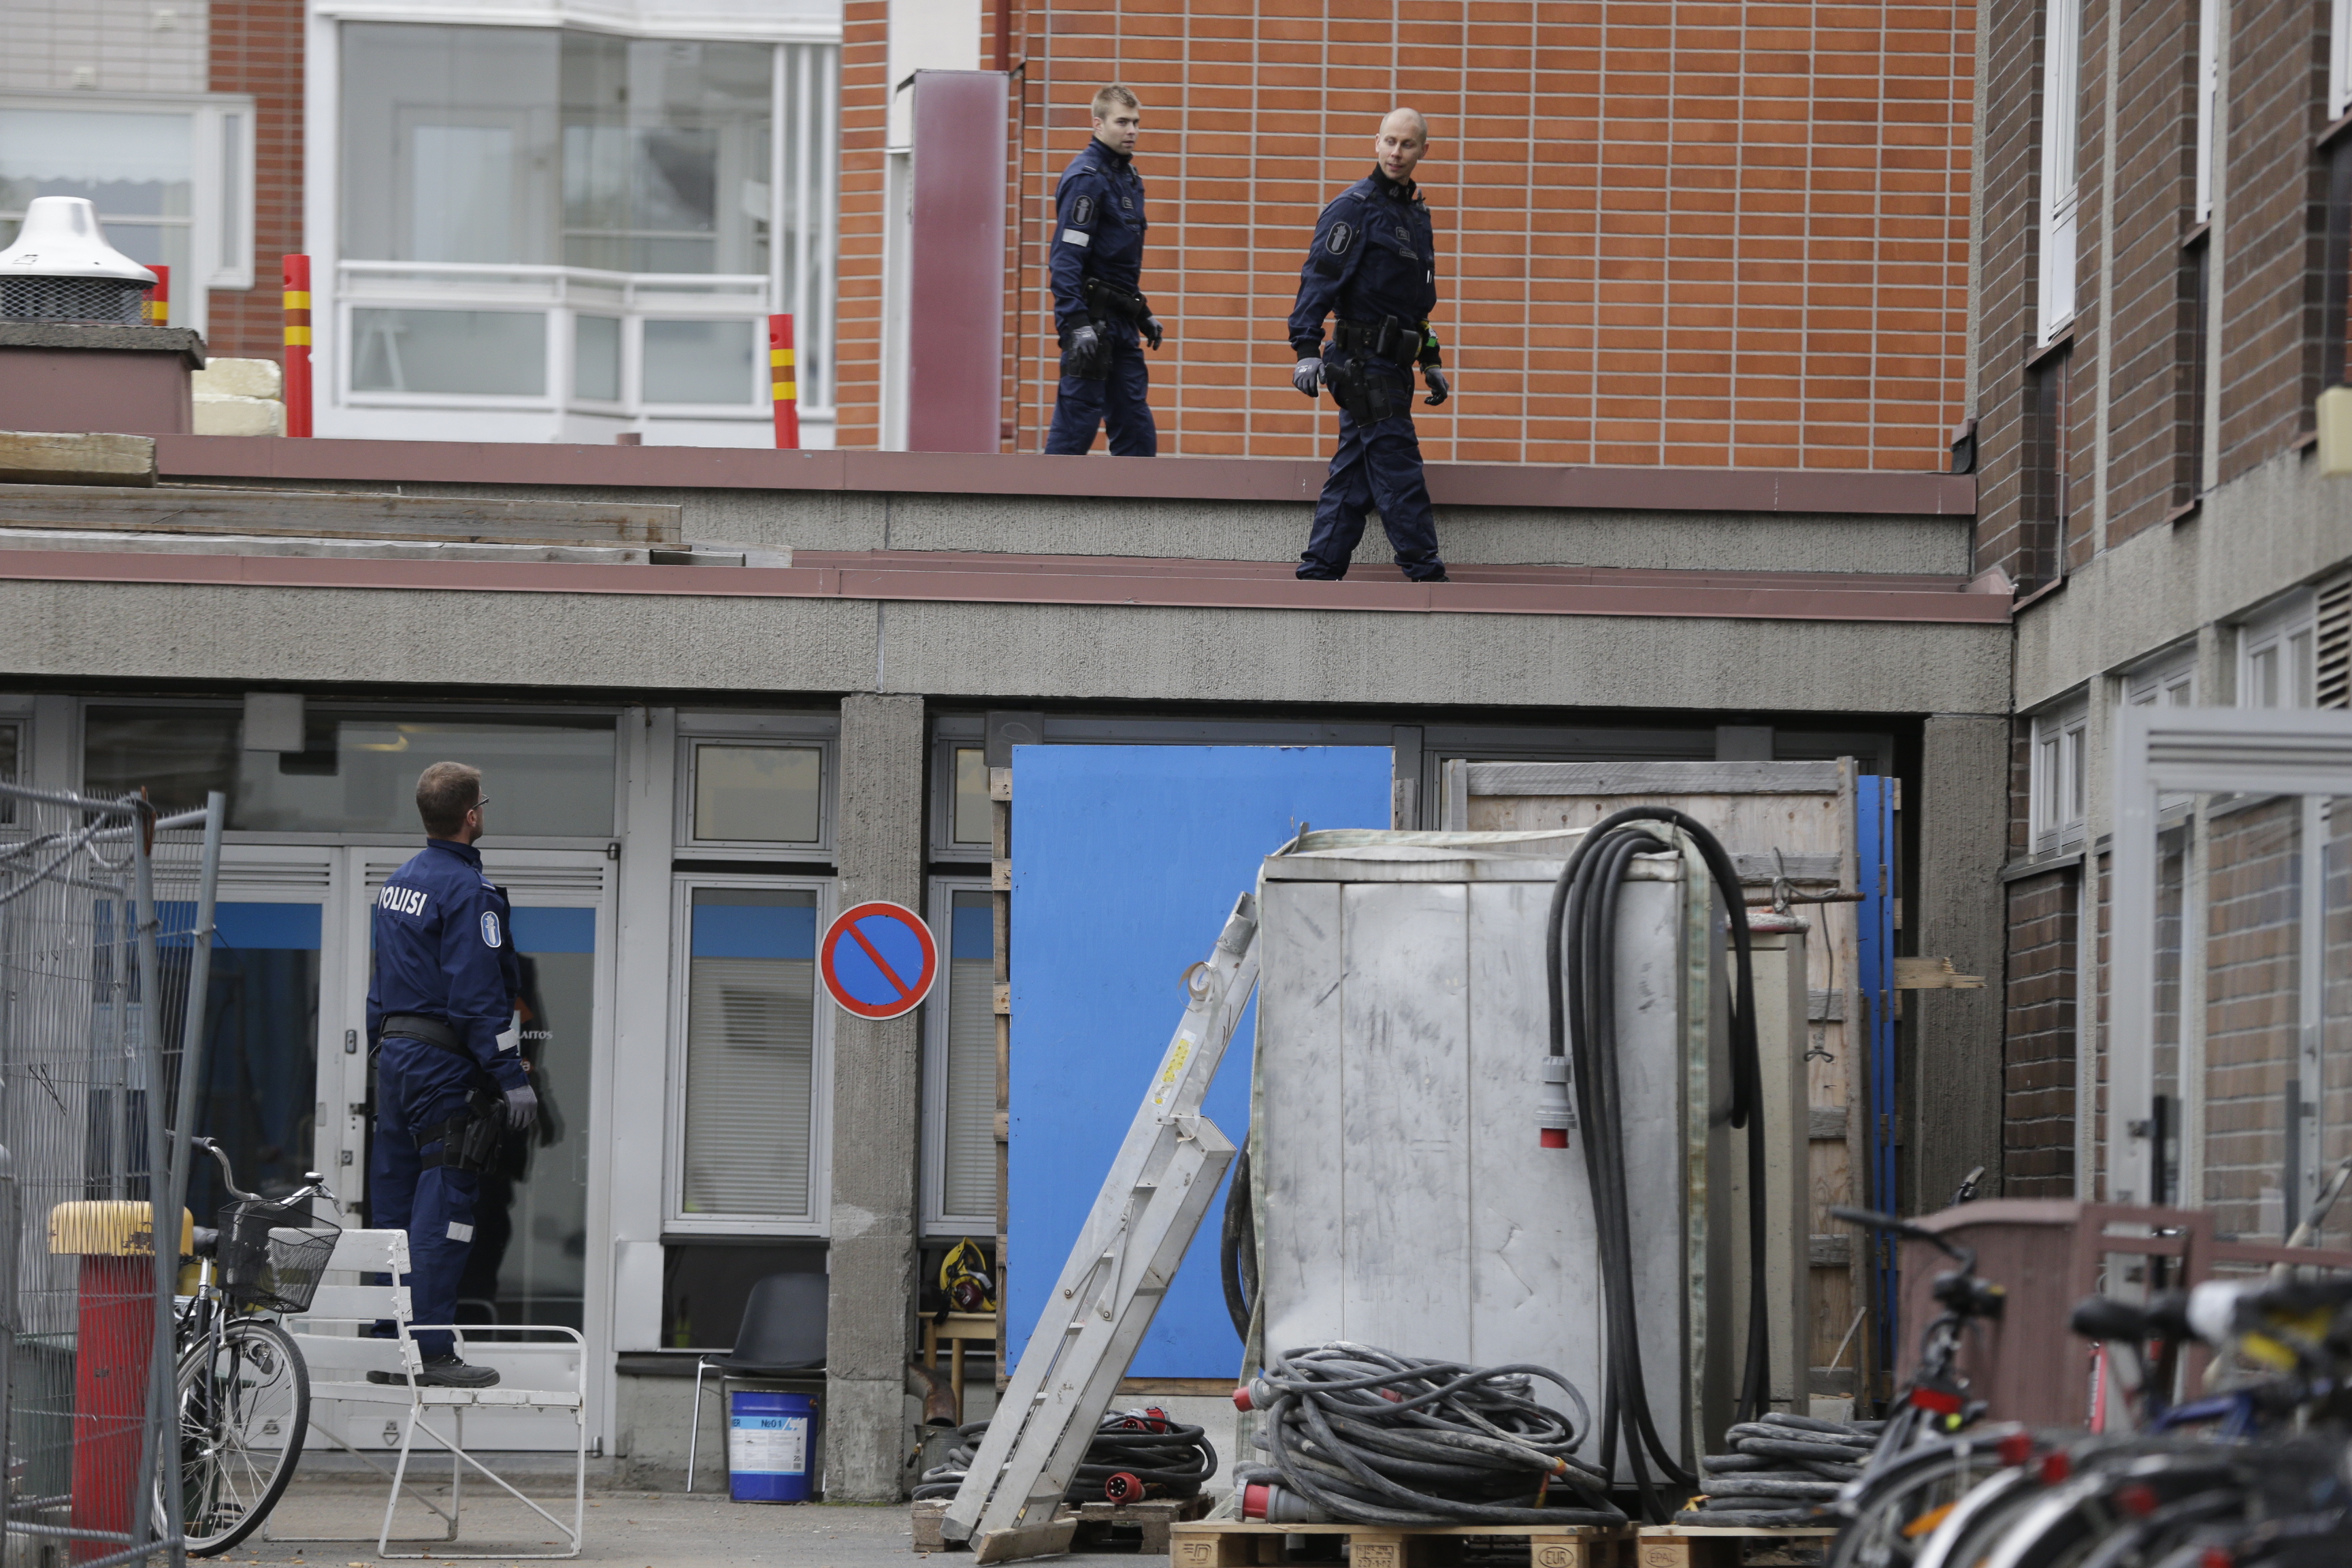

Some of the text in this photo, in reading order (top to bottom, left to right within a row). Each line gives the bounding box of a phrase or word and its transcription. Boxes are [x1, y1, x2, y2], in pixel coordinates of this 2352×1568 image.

[378, 886, 427, 916] POLIISI
[1546, 1551, 1566, 1565] EUR
[1650, 1552, 1675, 1563] EPAL
